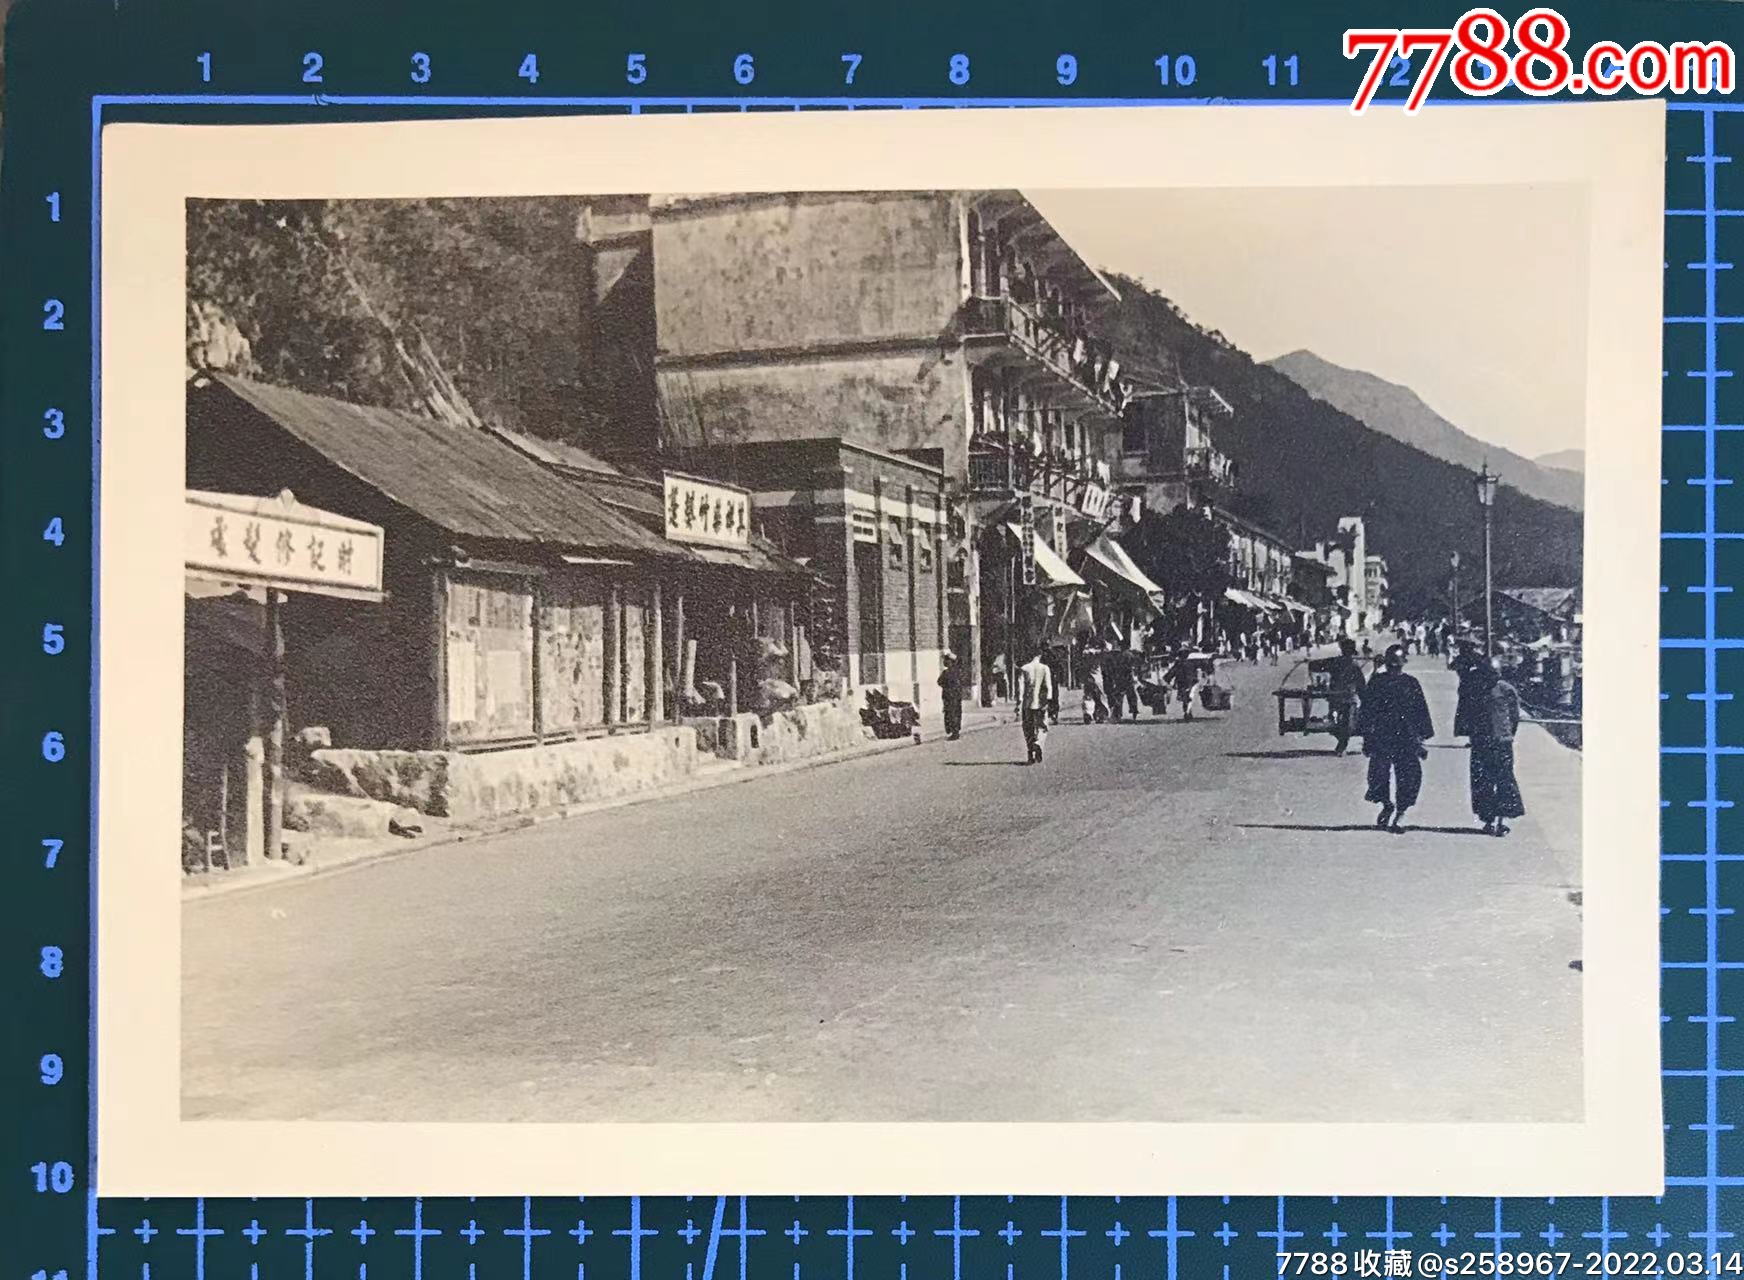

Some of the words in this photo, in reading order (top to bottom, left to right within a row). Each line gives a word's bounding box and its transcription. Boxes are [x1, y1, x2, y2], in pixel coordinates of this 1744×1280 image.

[197, 52, 211, 82] 1
[303, 52, 323, 83] 2
[411, 53, 432, 84] 3
[519, 53, 540, 84] 4
[627, 54, 647, 85] 5
[734, 54, 755, 85] 6
[842, 54, 863, 85] 7
[949, 54, 970, 86] 8
[1057, 54, 1078, 86] 9
[1155, 54, 1197, 86] 10
[1263, 54, 1299, 86] 11
[1369, 55, 1412, 87] 2
[46, 192, 60, 222] 1
[43, 299, 64, 330] 2
[43, 408, 65, 439] 3
[43, 517, 65, 546] 4
[43, 623, 65, 655] 5
[42, 731, 65, 763] 6
[41, 838, 64, 869] 7
[40, 945, 64, 979] 8
[40, 1053, 64, 1085] 9
[30, 1161, 75, 1193] 10
